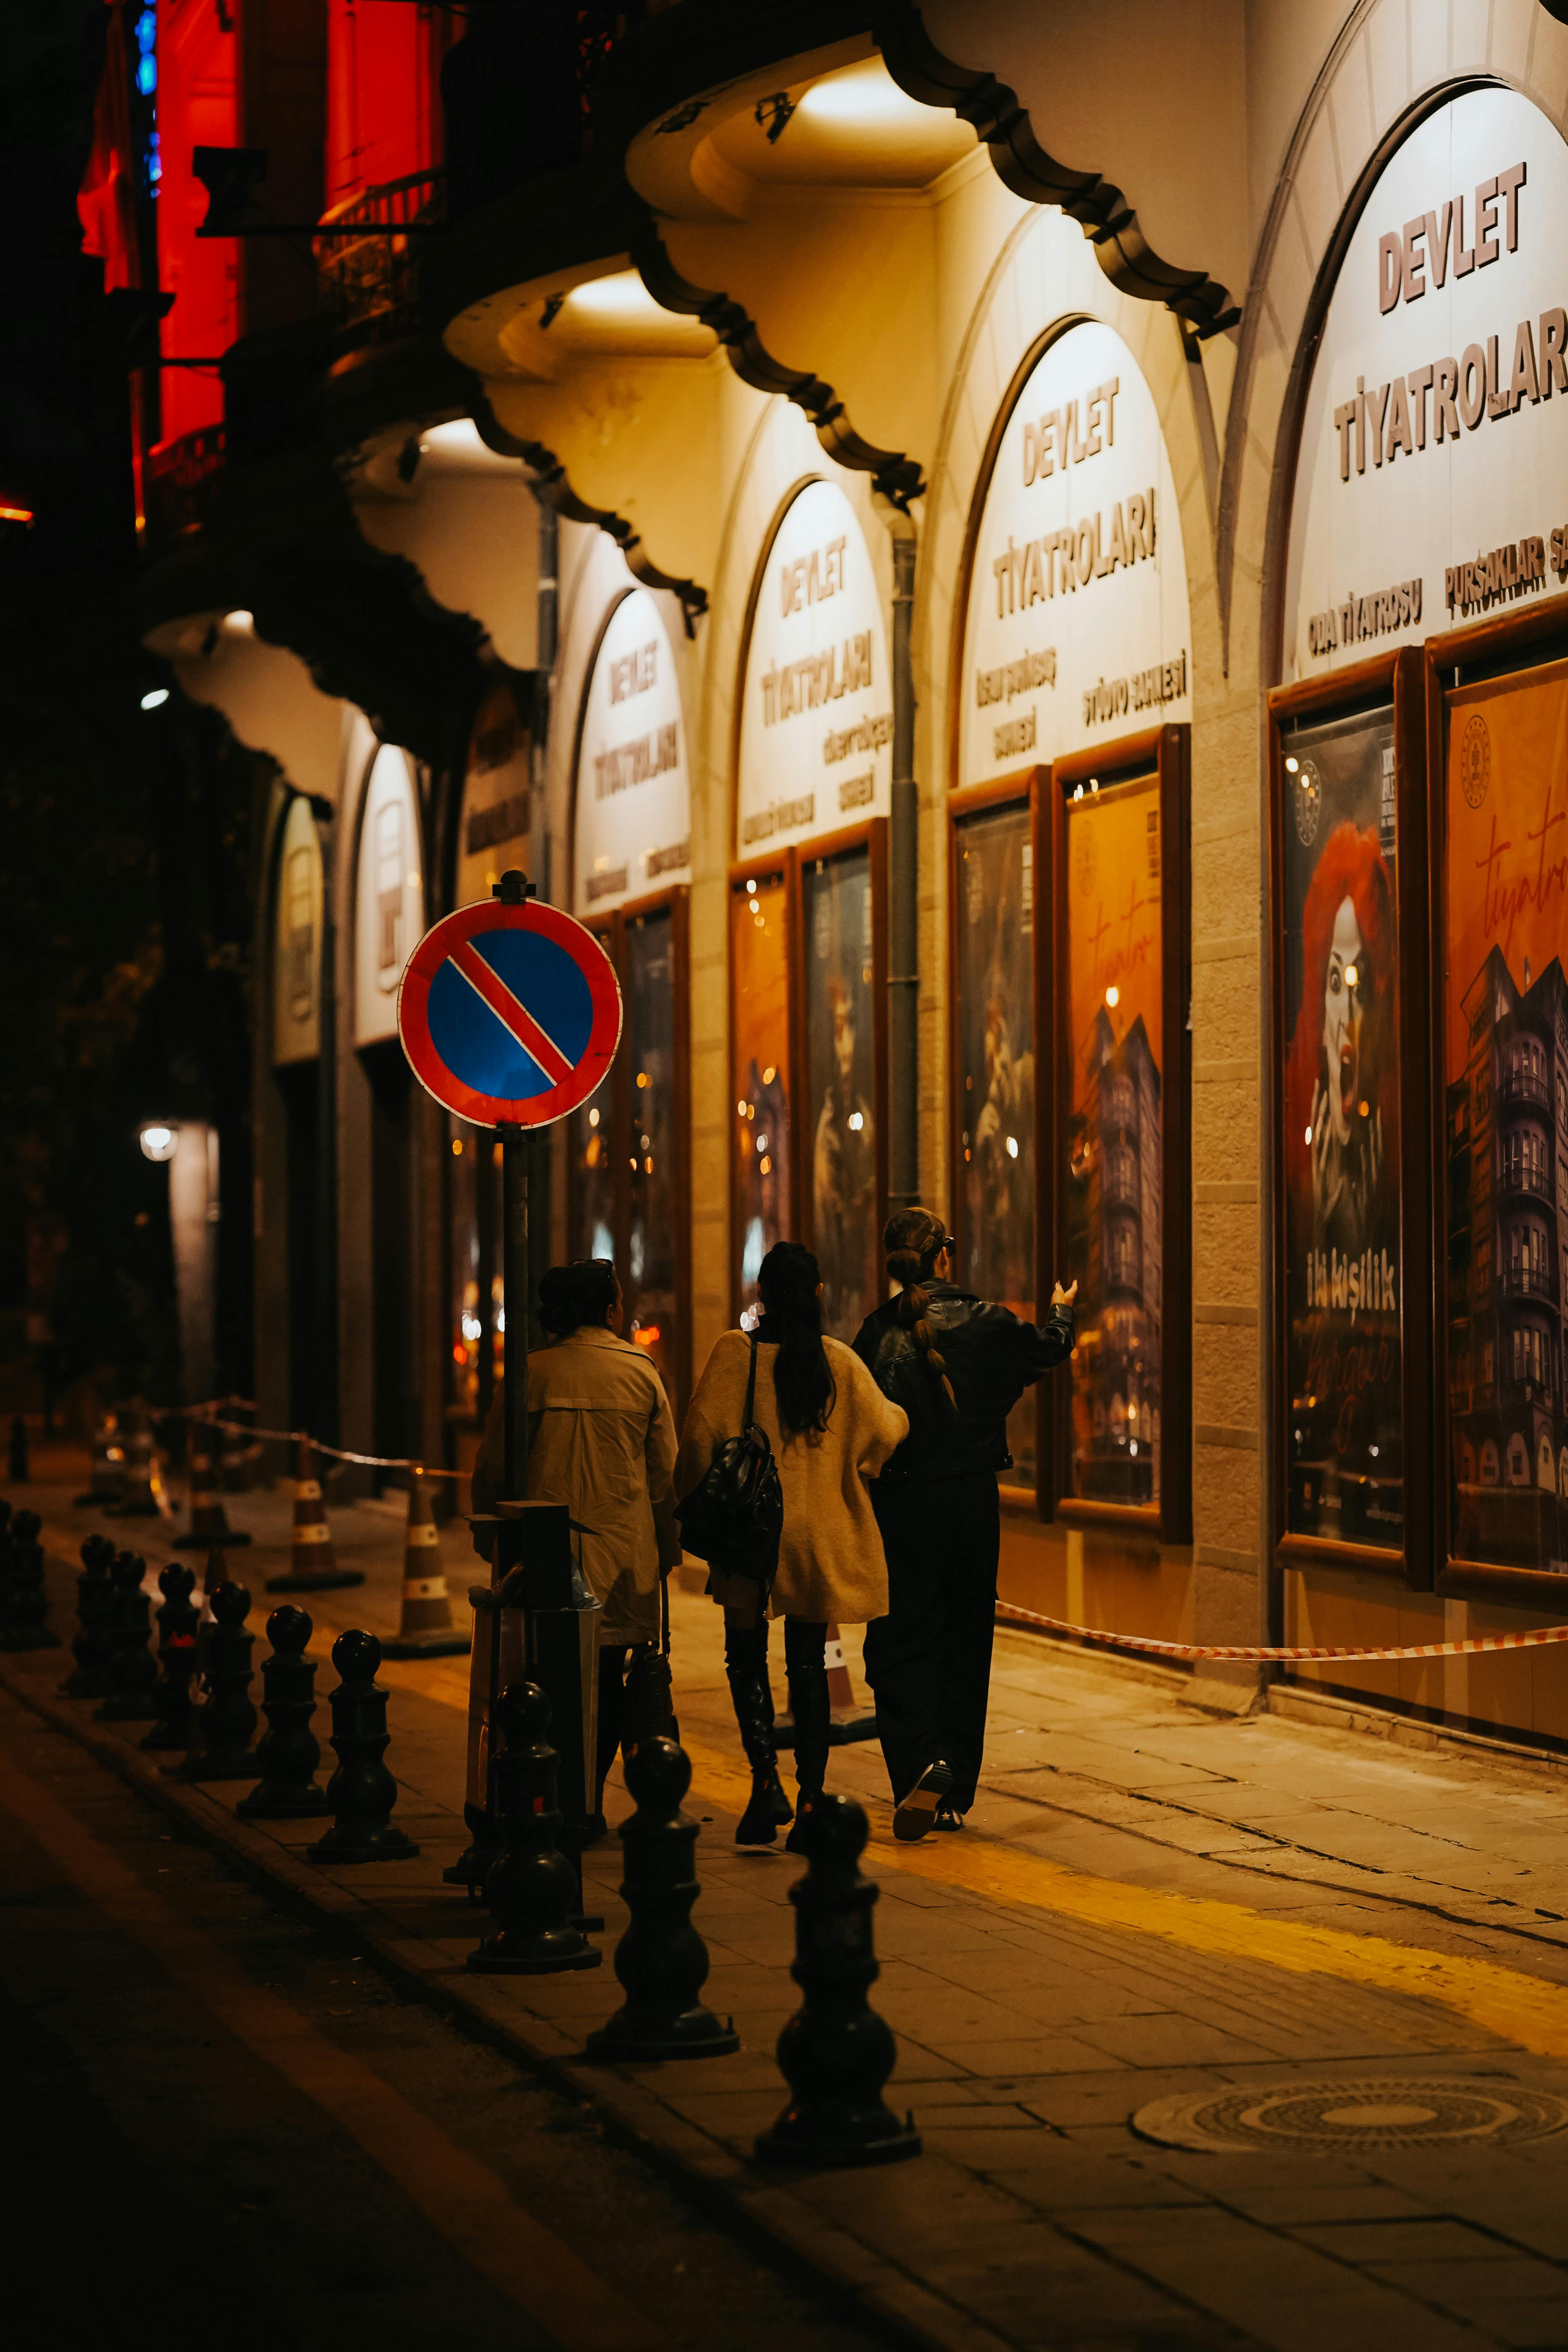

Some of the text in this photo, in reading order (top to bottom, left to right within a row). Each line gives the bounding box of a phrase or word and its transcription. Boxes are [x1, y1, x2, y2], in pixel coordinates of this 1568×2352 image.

[1379, 162, 1526, 316] DEVLET
[1023, 377, 1119, 487] DEVLET
[1334, 308, 1568, 483] TİYATROLAR
[782, 536, 846, 618] DEVLET
[994, 487, 1156, 619] TİYATROLARI
[1445, 536, 1546, 614] PURSAKLAR
